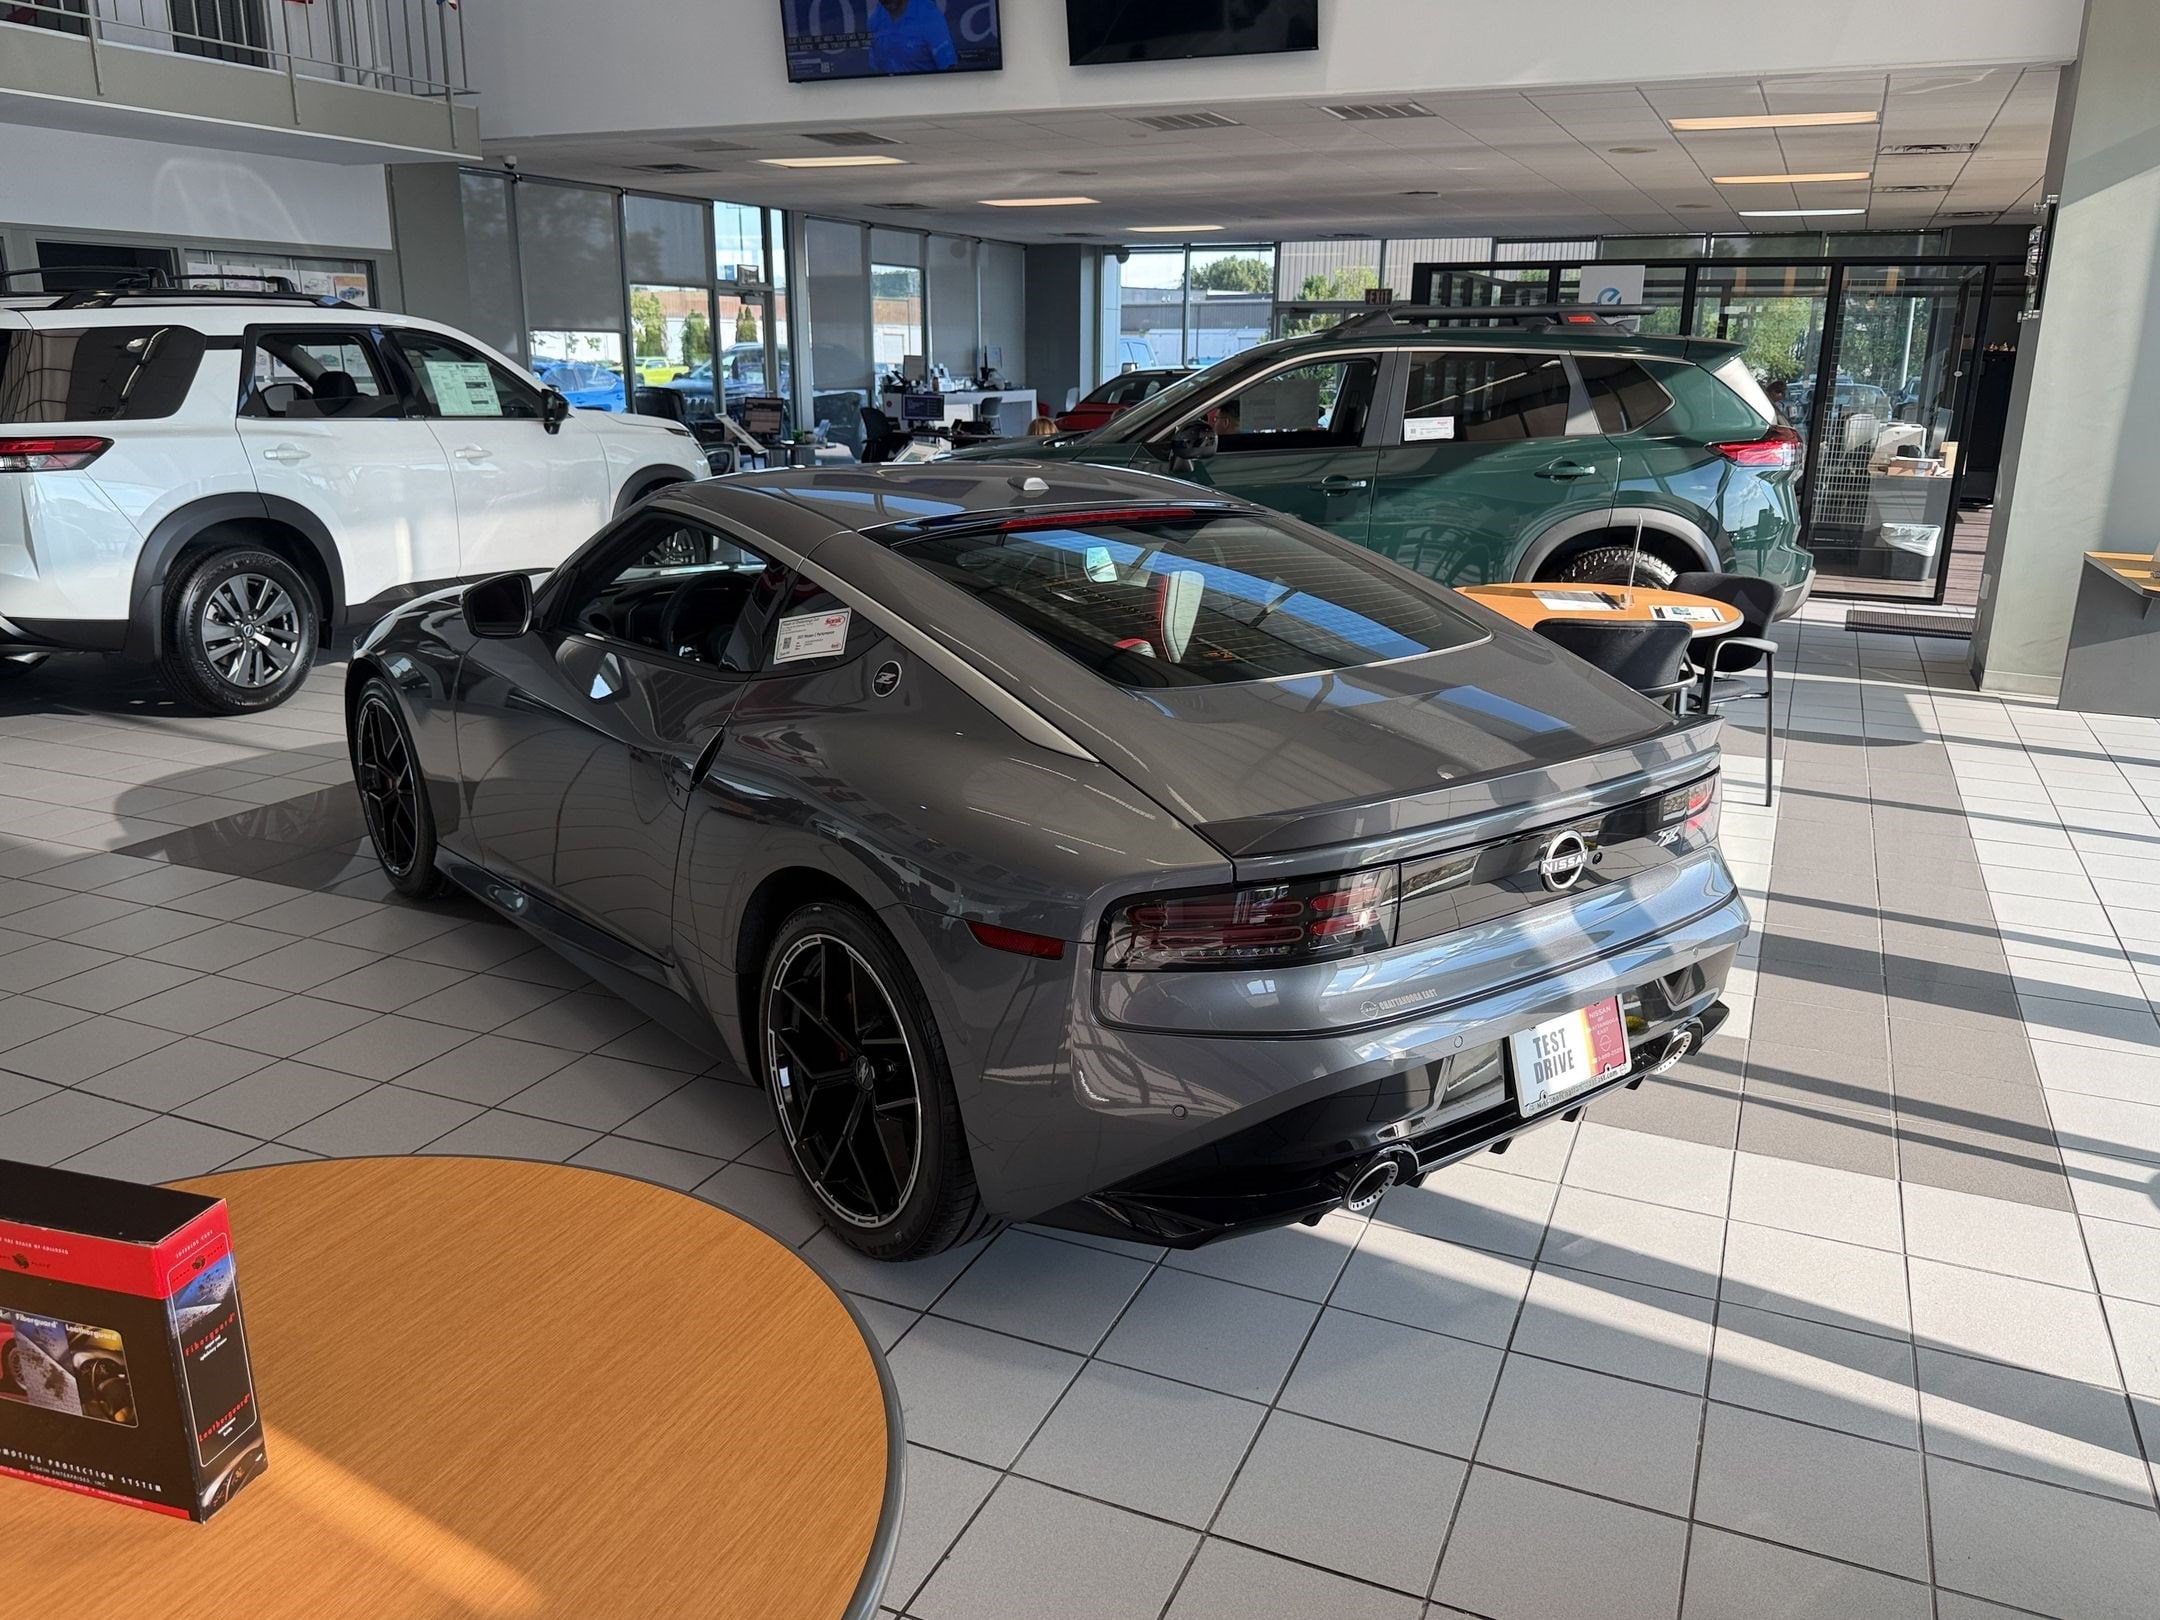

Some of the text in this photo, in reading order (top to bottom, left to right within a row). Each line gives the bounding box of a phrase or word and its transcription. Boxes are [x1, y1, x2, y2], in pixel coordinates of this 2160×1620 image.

[1370, 291, 1388, 304] EXIT
[1656, 826, 1680, 846] Z
[1542, 848, 1588, 875] NISSAN
[1379, 991, 1423, 1010] CHATTANOOGA
[1421, 988, 1438, 999] EAST
[1589, 1006, 1611, 1019] NISSAN
[1533, 1028, 1566, 1058] TEST
[1534, 1049, 1574, 1084] DRIVE
[0, 1448, 162, 1493] MOTIVE PROTECTION SYSTEM
